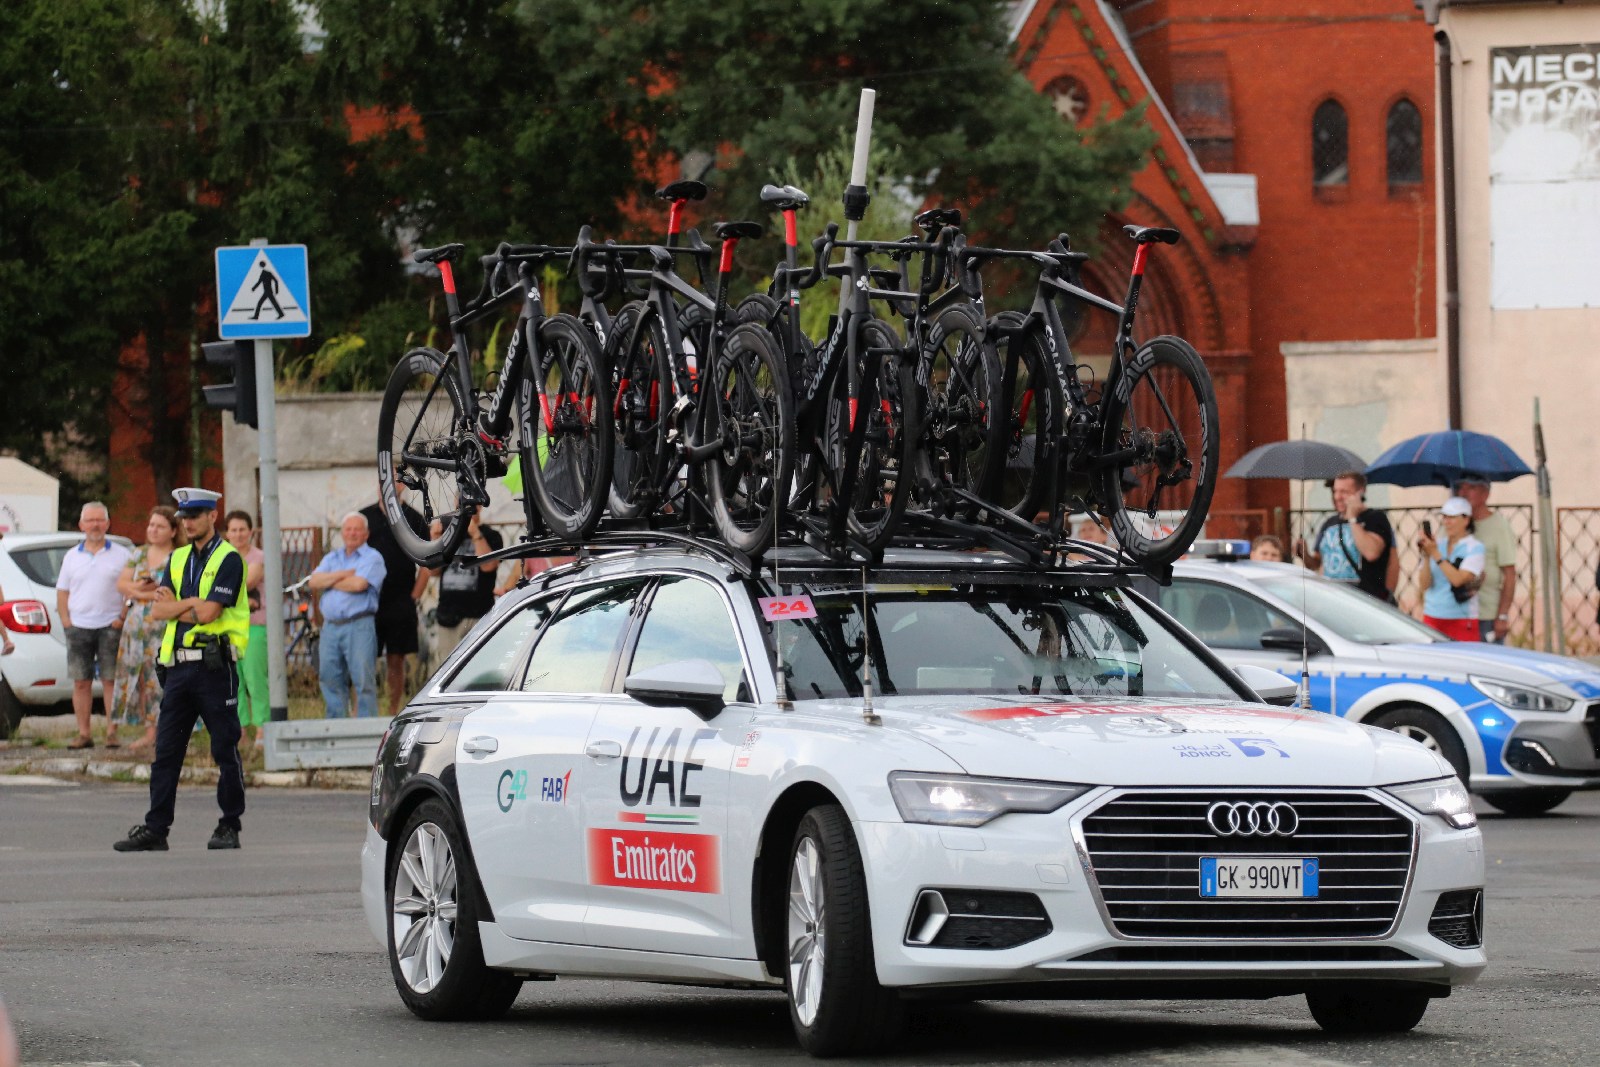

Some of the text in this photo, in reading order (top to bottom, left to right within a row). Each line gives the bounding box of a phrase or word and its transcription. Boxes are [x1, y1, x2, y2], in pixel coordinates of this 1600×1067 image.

[1493, 53, 1600, 84] MEC
[1493, 87, 1600, 116] POJA
[488, 328, 520, 423] COLNAGO
[808, 316, 844, 401] COLNAGO
[1045, 324, 1073, 418] COLNAGO
[768, 600, 809, 616] 24
[619, 726, 719, 808] UAE
[1179, 750, 1232, 758] ADNOC
[611, 835, 697, 884] Emirates
[1217, 865, 1239, 889] GK
